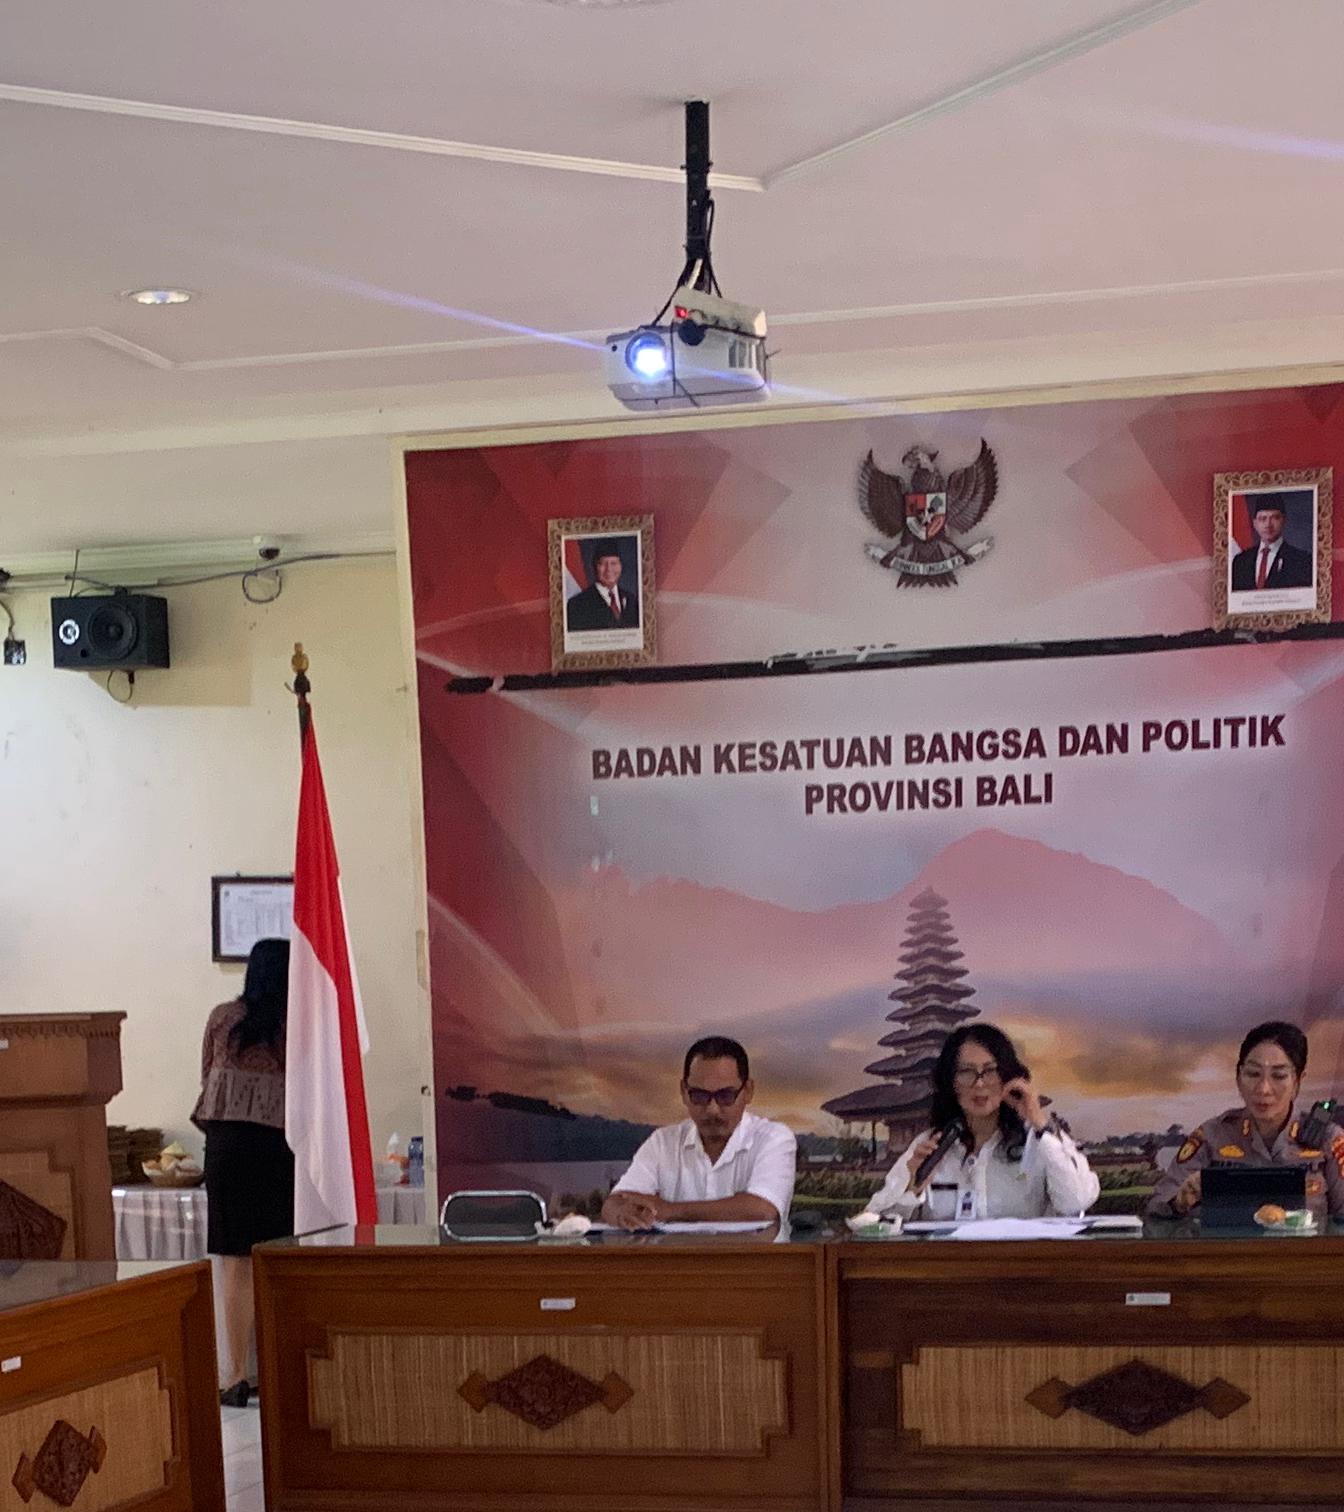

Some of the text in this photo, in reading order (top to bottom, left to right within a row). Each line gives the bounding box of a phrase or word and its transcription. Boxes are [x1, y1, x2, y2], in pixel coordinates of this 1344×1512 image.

[591, 714, 1286, 780] BADAN KESATUAN BANGSA DAN POLITIK
[805, 773, 1053, 815] PROVINSI BALI
